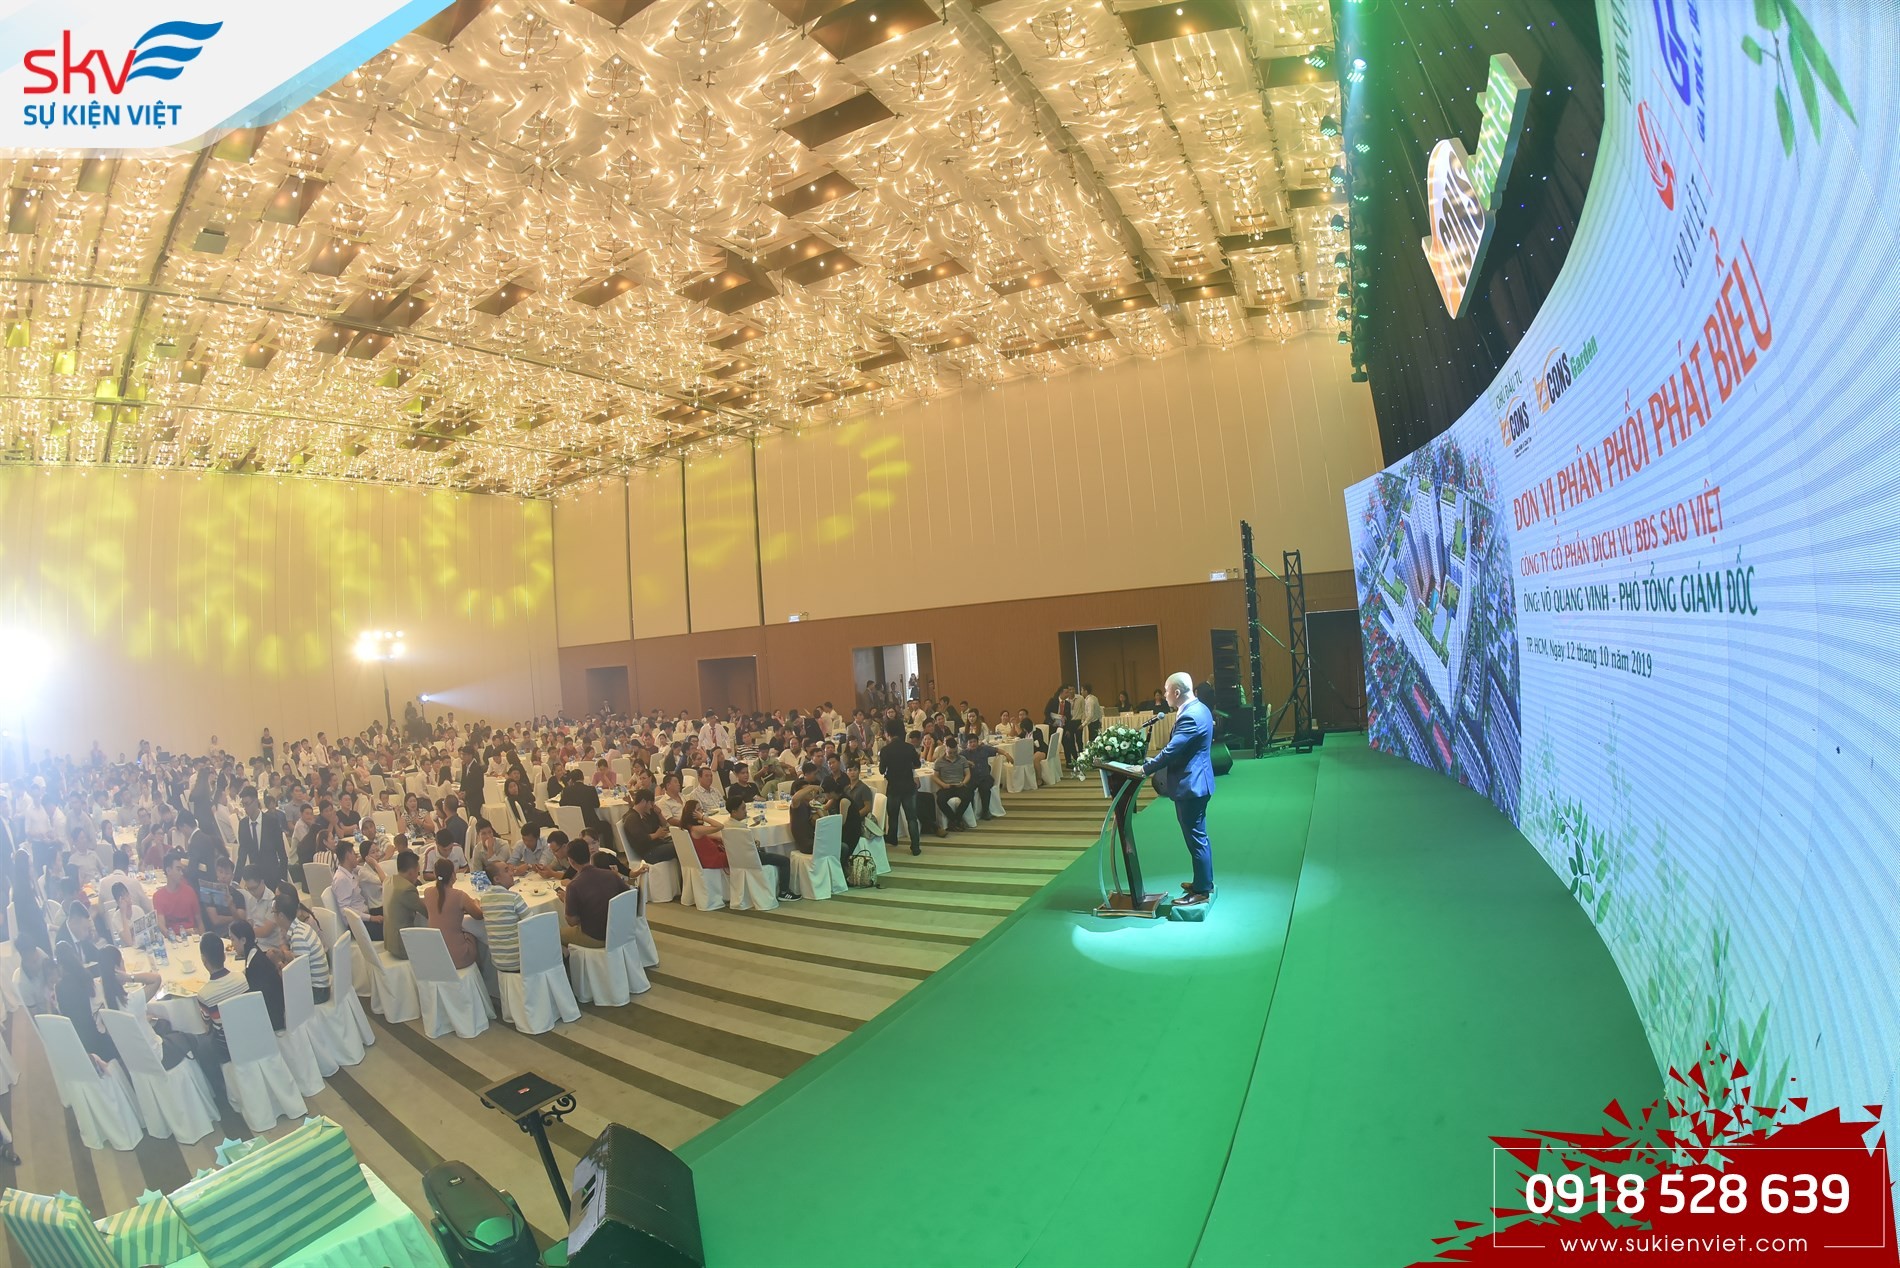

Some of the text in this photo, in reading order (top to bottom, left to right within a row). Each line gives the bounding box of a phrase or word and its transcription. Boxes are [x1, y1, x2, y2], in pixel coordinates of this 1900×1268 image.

[1513, 226, 1773, 531] ĐƠN VỊ PHÂN PHỐI PHÁT BIỂU
[1570, 335, 1598, 380] Garden
[1520, 551, 1540, 577] CÔNG
[1540, 552, 1549, 573] TY
[1551, 535, 1563, 571] CỔ
[1592, 530, 1617, 568] DỊCH
[1618, 524, 1633, 562] VỤ
[1634, 515, 1659, 552] BĐS
[1660, 503, 1688, 546] SAO
[1689, 478, 1723, 544] VIỆT
[1524, 588, 1540, 612] ÔNG:
[1540, 586, 1552, 612] VÕ
[1554, 587, 1584, 613] QUANG
[1585, 584, 1609, 611] VINH
[1619, 571, 1641, 612] PHÓ
[1642, 561, 1677, 613] TỔNG
[1681, 561, 1724, 613] GIÁM
[1726, 544, 1758, 616] ĐỐC
[1550, 639, 1565, 662] Ngày
[1567, 641, 1576, 660] 12
[1577, 642, 1597, 669] tháng
[1599, 645, 1609, 667] 10
[1611, 649, 1629, 672] năm
[1631, 650, 1652, 678] 2019
